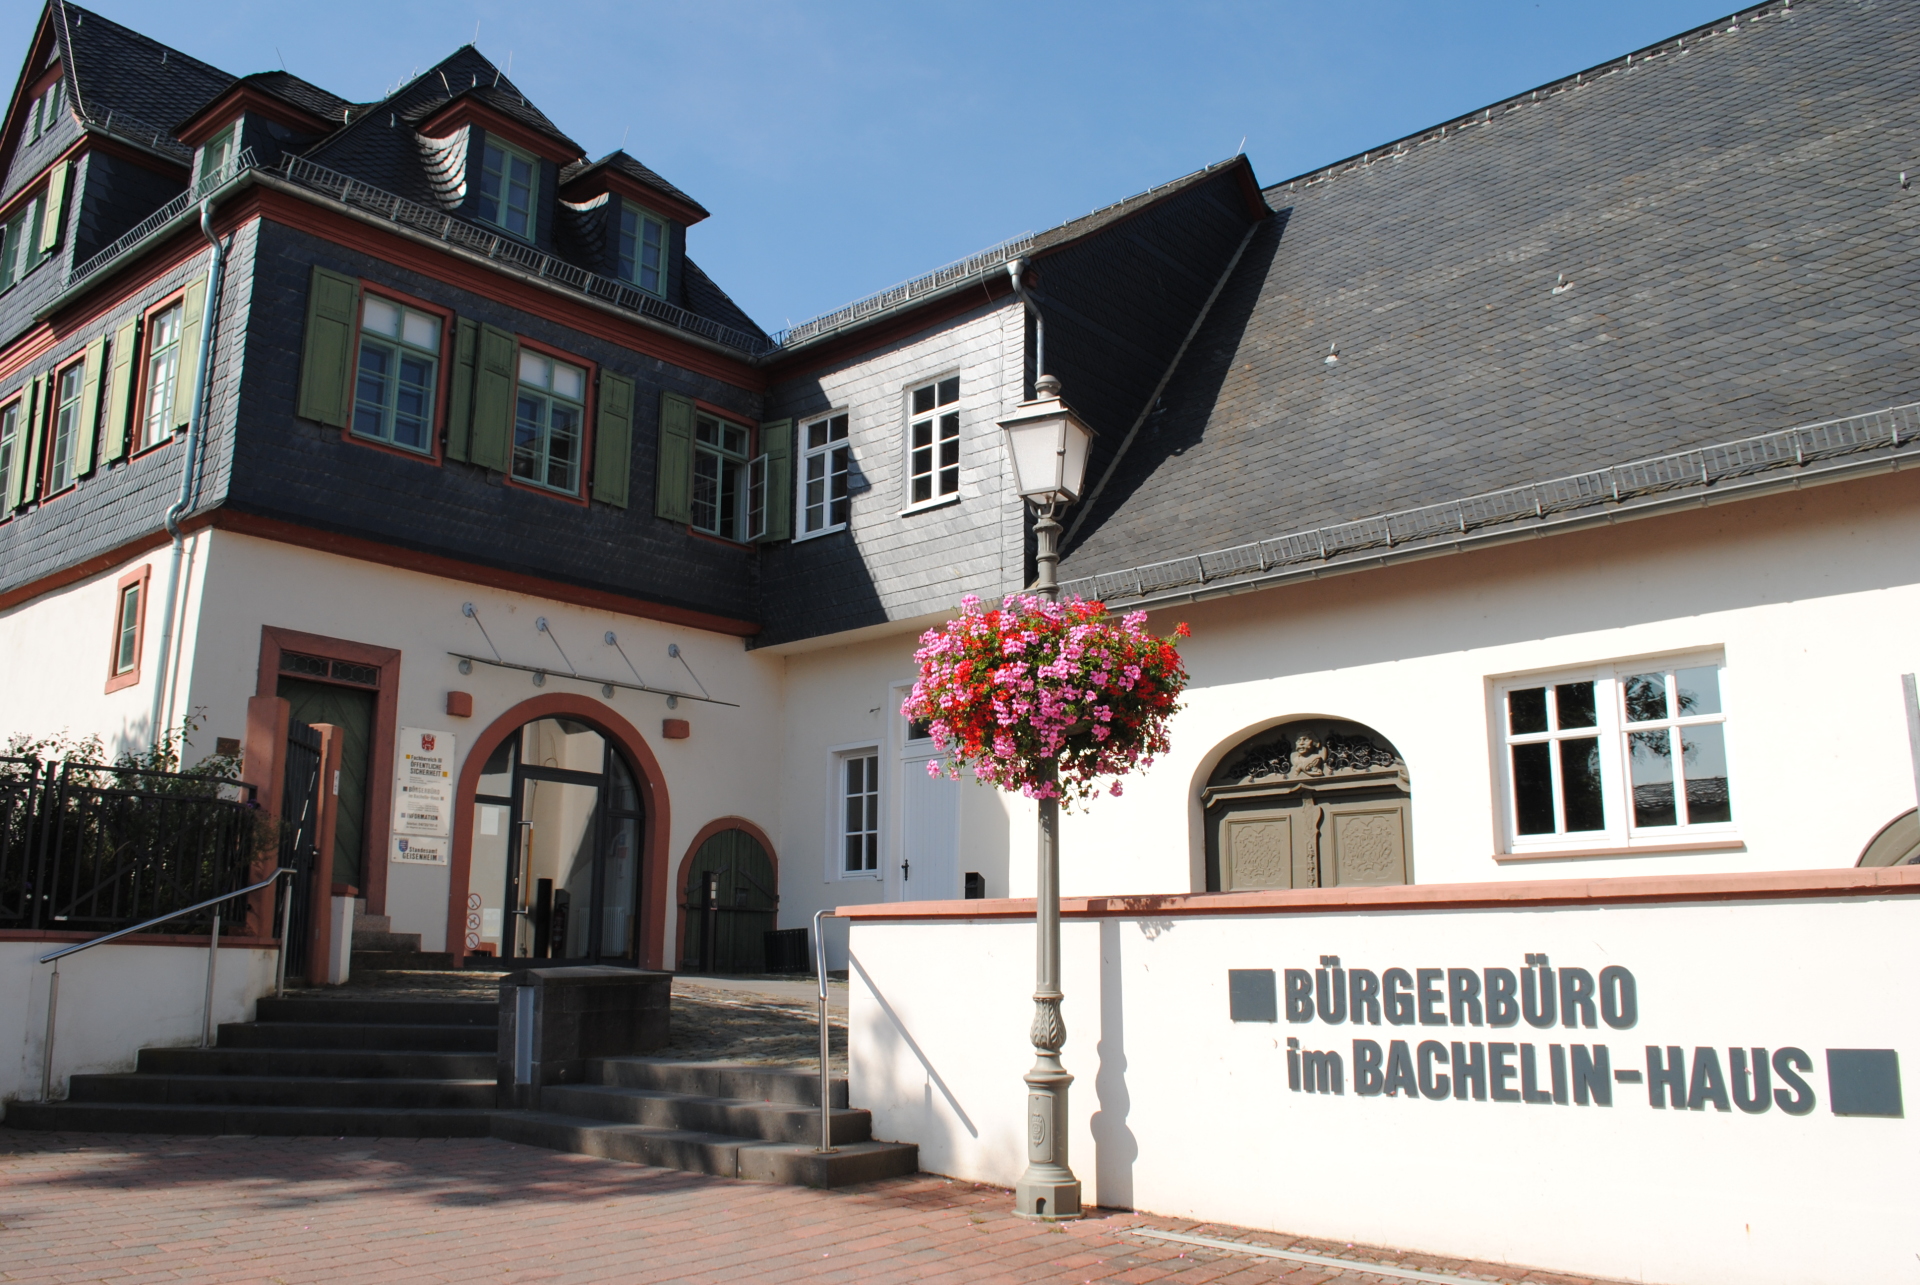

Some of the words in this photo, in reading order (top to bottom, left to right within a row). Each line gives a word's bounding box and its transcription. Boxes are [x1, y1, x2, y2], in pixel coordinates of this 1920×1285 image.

[410, 760, 442, 770] ÖFFENTLICHE
[410, 768, 441, 777] SICHERHEIT
[407, 812, 438, 820] INFORMATION
[409, 846, 438, 854] Standesamt
[402, 853, 437, 861] GEISENHEIM
[1284, 953, 1638, 1029] BÜRGERBÜRO
[1286, 1037, 1344, 1094] im
[1353, 1039, 1816, 1116] BACHELIN-HAUS
